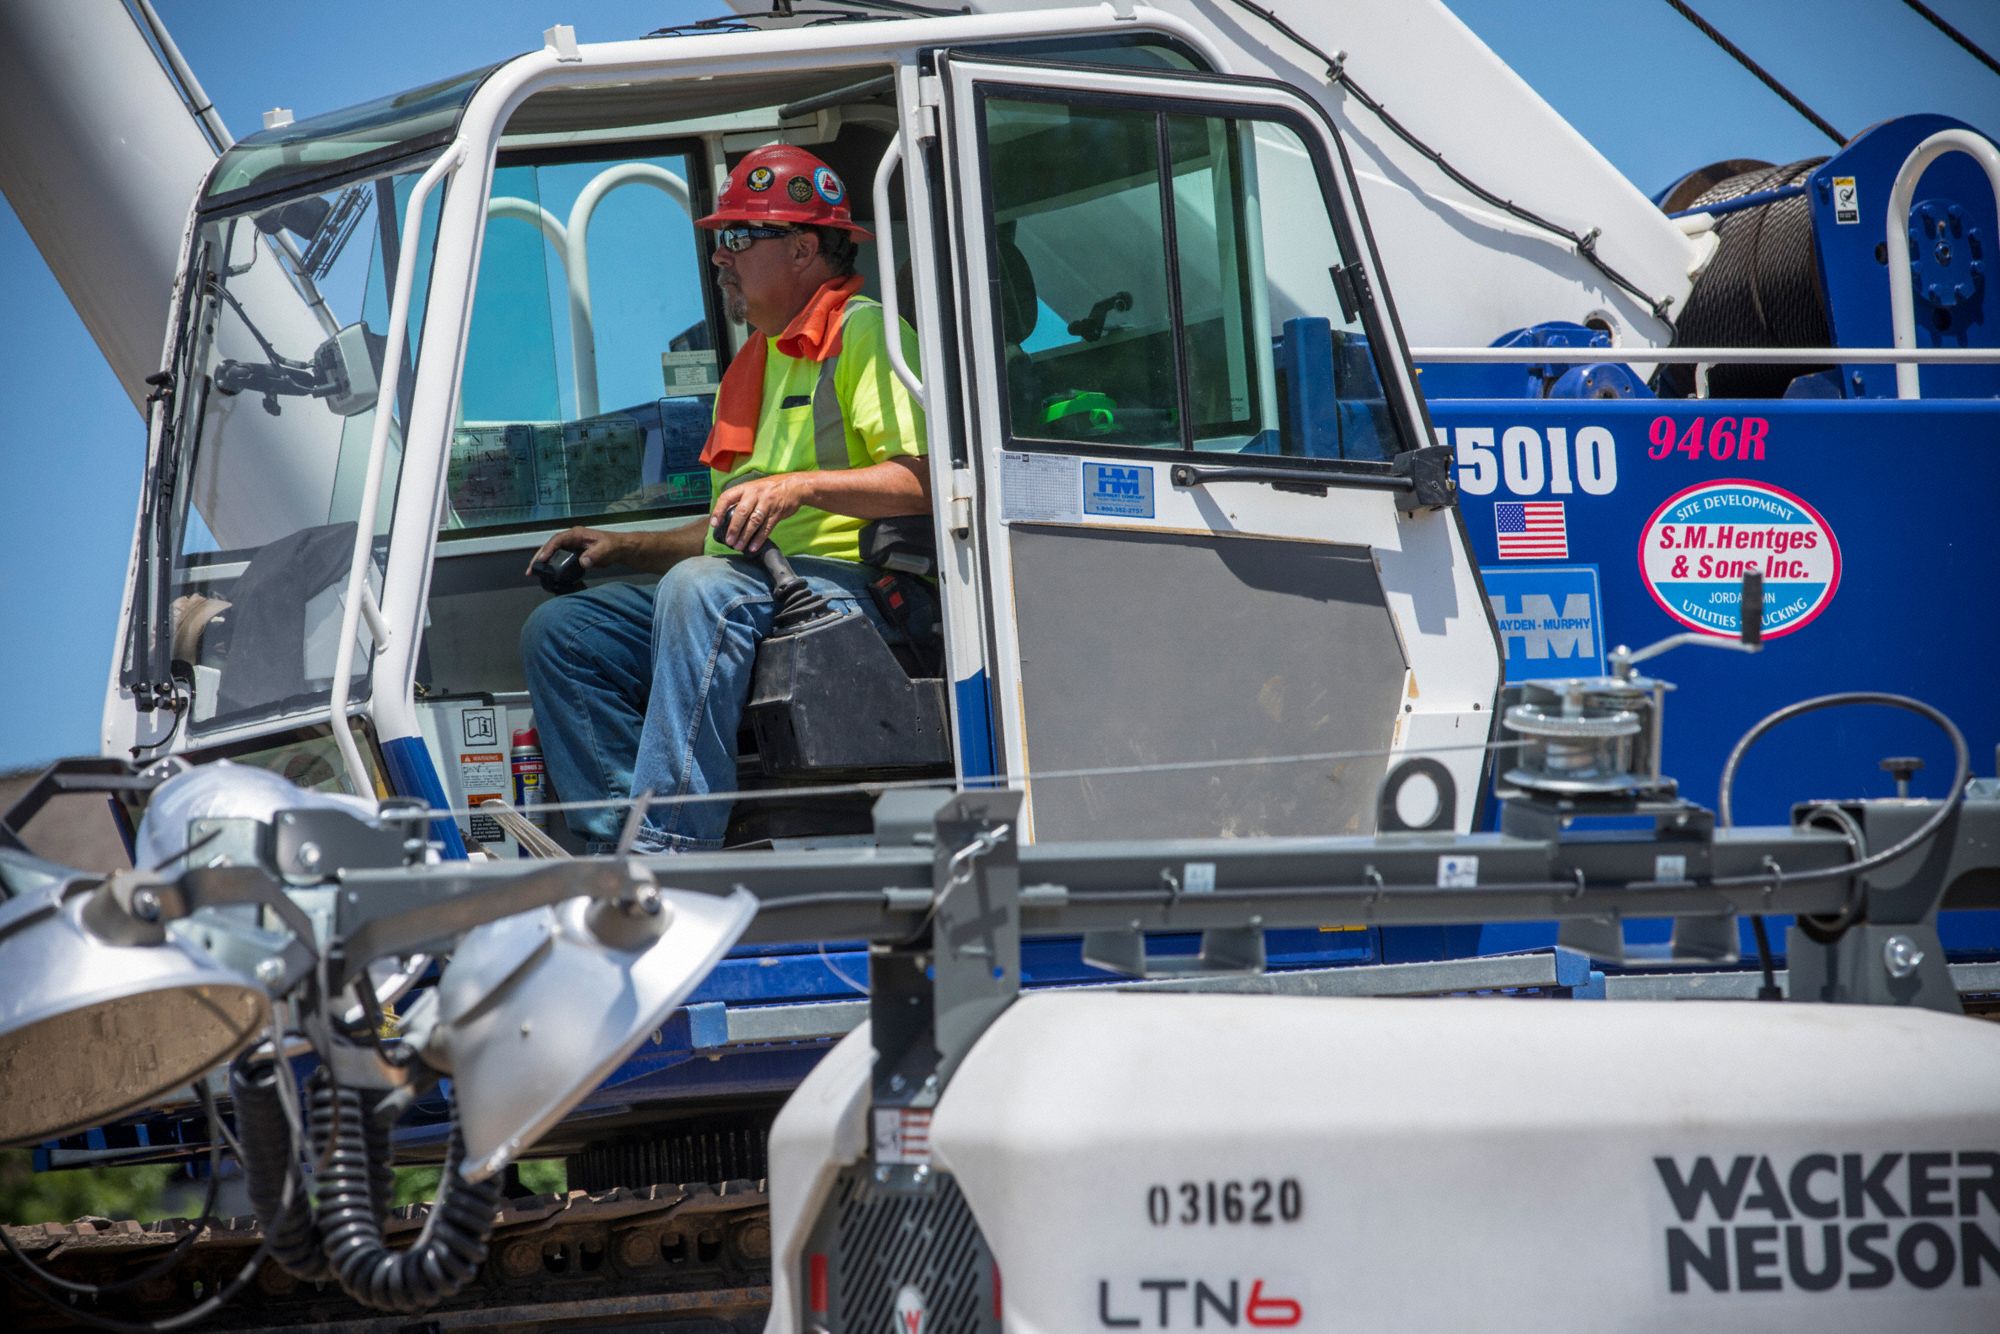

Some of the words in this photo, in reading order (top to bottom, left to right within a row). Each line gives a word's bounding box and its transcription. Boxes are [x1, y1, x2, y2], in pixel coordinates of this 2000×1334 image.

[1434, 426, 1617, 495] 5010
[1648, 416, 1771, 462] 946R
[1098, 467, 1139, 495] HM
[1676, 501, 1701, 521] SITE
[1703, 494, 1795, 522] DEVELOPMENT
[1671, 555, 1690, 579] &
[1698, 555, 1759, 579] Sons
[1765, 556, 1810, 579] Inc.
[1488, 593, 1595, 660] HM
[1682, 598, 1737, 628] UTILITIES
[1761, 597, 1808, 627] UCKING
[1148, 1177, 1303, 1226] 031620
[1652, 1151, 2000, 1222] WACKER
[1665, 1222, 2000, 1294] NEUSON
[1099, 1278, 1303, 1329] LTN6
